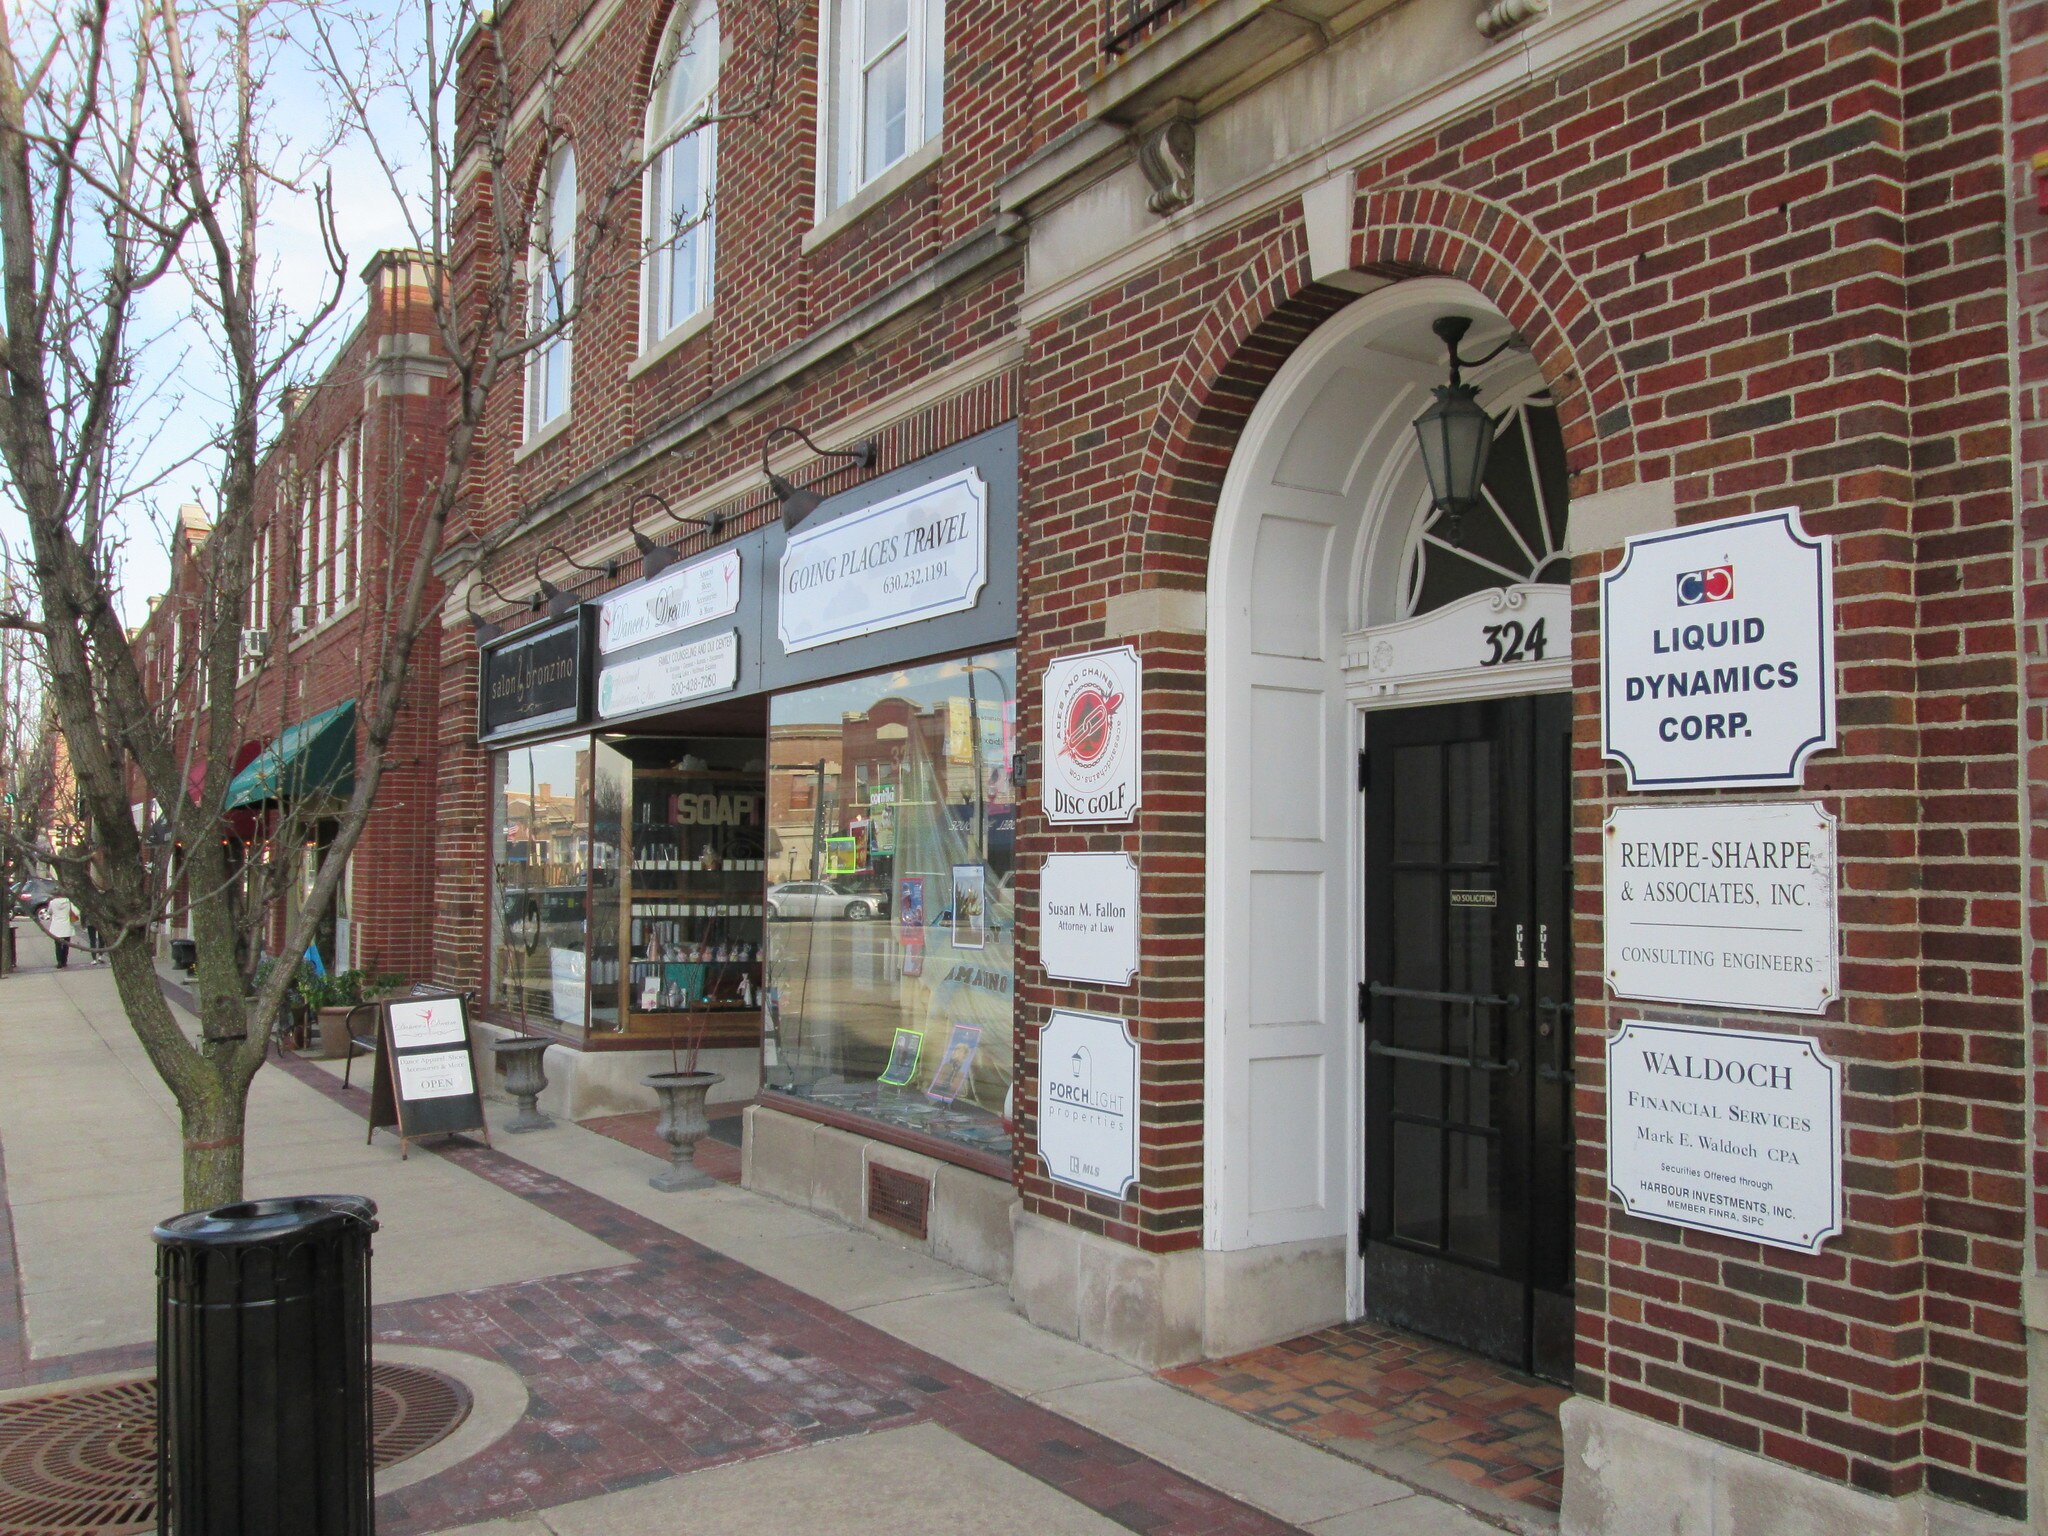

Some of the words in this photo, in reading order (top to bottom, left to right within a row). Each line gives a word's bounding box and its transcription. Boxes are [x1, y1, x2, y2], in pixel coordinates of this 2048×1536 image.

[789, 556, 837, 594] GOING
[839, 535, 899, 578] PLACES
[903, 511, 969, 558] TRAVEL
[883, 561, 948, 594] 630.232.1191
[655, 585, 690, 627] Dream
[716, 635, 733, 650] CENTER
[1479, 616, 1548, 666] 324
[1653, 617, 1765, 654] LIQUID
[492, 674, 516, 699] salon
[526, 656, 573, 689] bronzino
[1626, 661, 1799, 701] DYNAMICS
[1056, 701, 1065, 739] ACES
[1064, 674, 1079, 695] AND
[1081, 668, 1114, 689] CHAINS
[1658, 712, 1752, 742] CORP.
[677, 793, 754, 825] SOAP
[1055, 787, 1085, 814] DISC
[1088, 782, 1126, 814] GOLF
[1620, 841, 1813, 869] REMPE-SHARPE
[1048, 901, 1075, 916] Susan
[1078, 903, 1092, 917] M.
[1095, 903, 1126, 918] Fallon
[1452, 894, 1461, 903] NO
[1462, 894, 1496, 903] SOLICITING
[1621, 881, 1634, 901] &
[1644, 882, 1760, 905] ASSOCIATES,
[1771, 883, 1812, 906] INC.
[1058, 921, 1087, 933] Attorney
[1090, 924, 1098, 932] at
[1099, 922, 1115, 933] Law
[1516, 924, 1524, 960] PULL
[1621, 946, 1715, 967] CONSULTING
[1723, 952, 1814, 973] ENGINEERS
[421, 1078, 454, 1089] OPEN
[1642, 1051, 1793, 1090] WALDOCH
[1049, 1105, 1124, 1132] properties
[1637, 1126, 1674, 1146] Mark
[1679, 1132, 1693, 1147] E.
[1699, 1135, 1758, 1158] Waldoch
[1767, 1148, 1800, 1165] CPA
[1082, 1163, 1100, 1177] MLS
[1661, 1162, 1701, 1178] Securities
[1703, 1170, 1737, 1184] Offered
[1739, 1176, 1773, 1191] through
[1640, 1180, 1690, 1198] HARBOUR
[1692, 1190, 1770, 1216] INVESTMENTS,
[1773, 1205, 1796, 1220] INC.
[1667, 1199, 1706, 1214] MEMBER
[1742, 1214, 1765, 1226] SIPC
